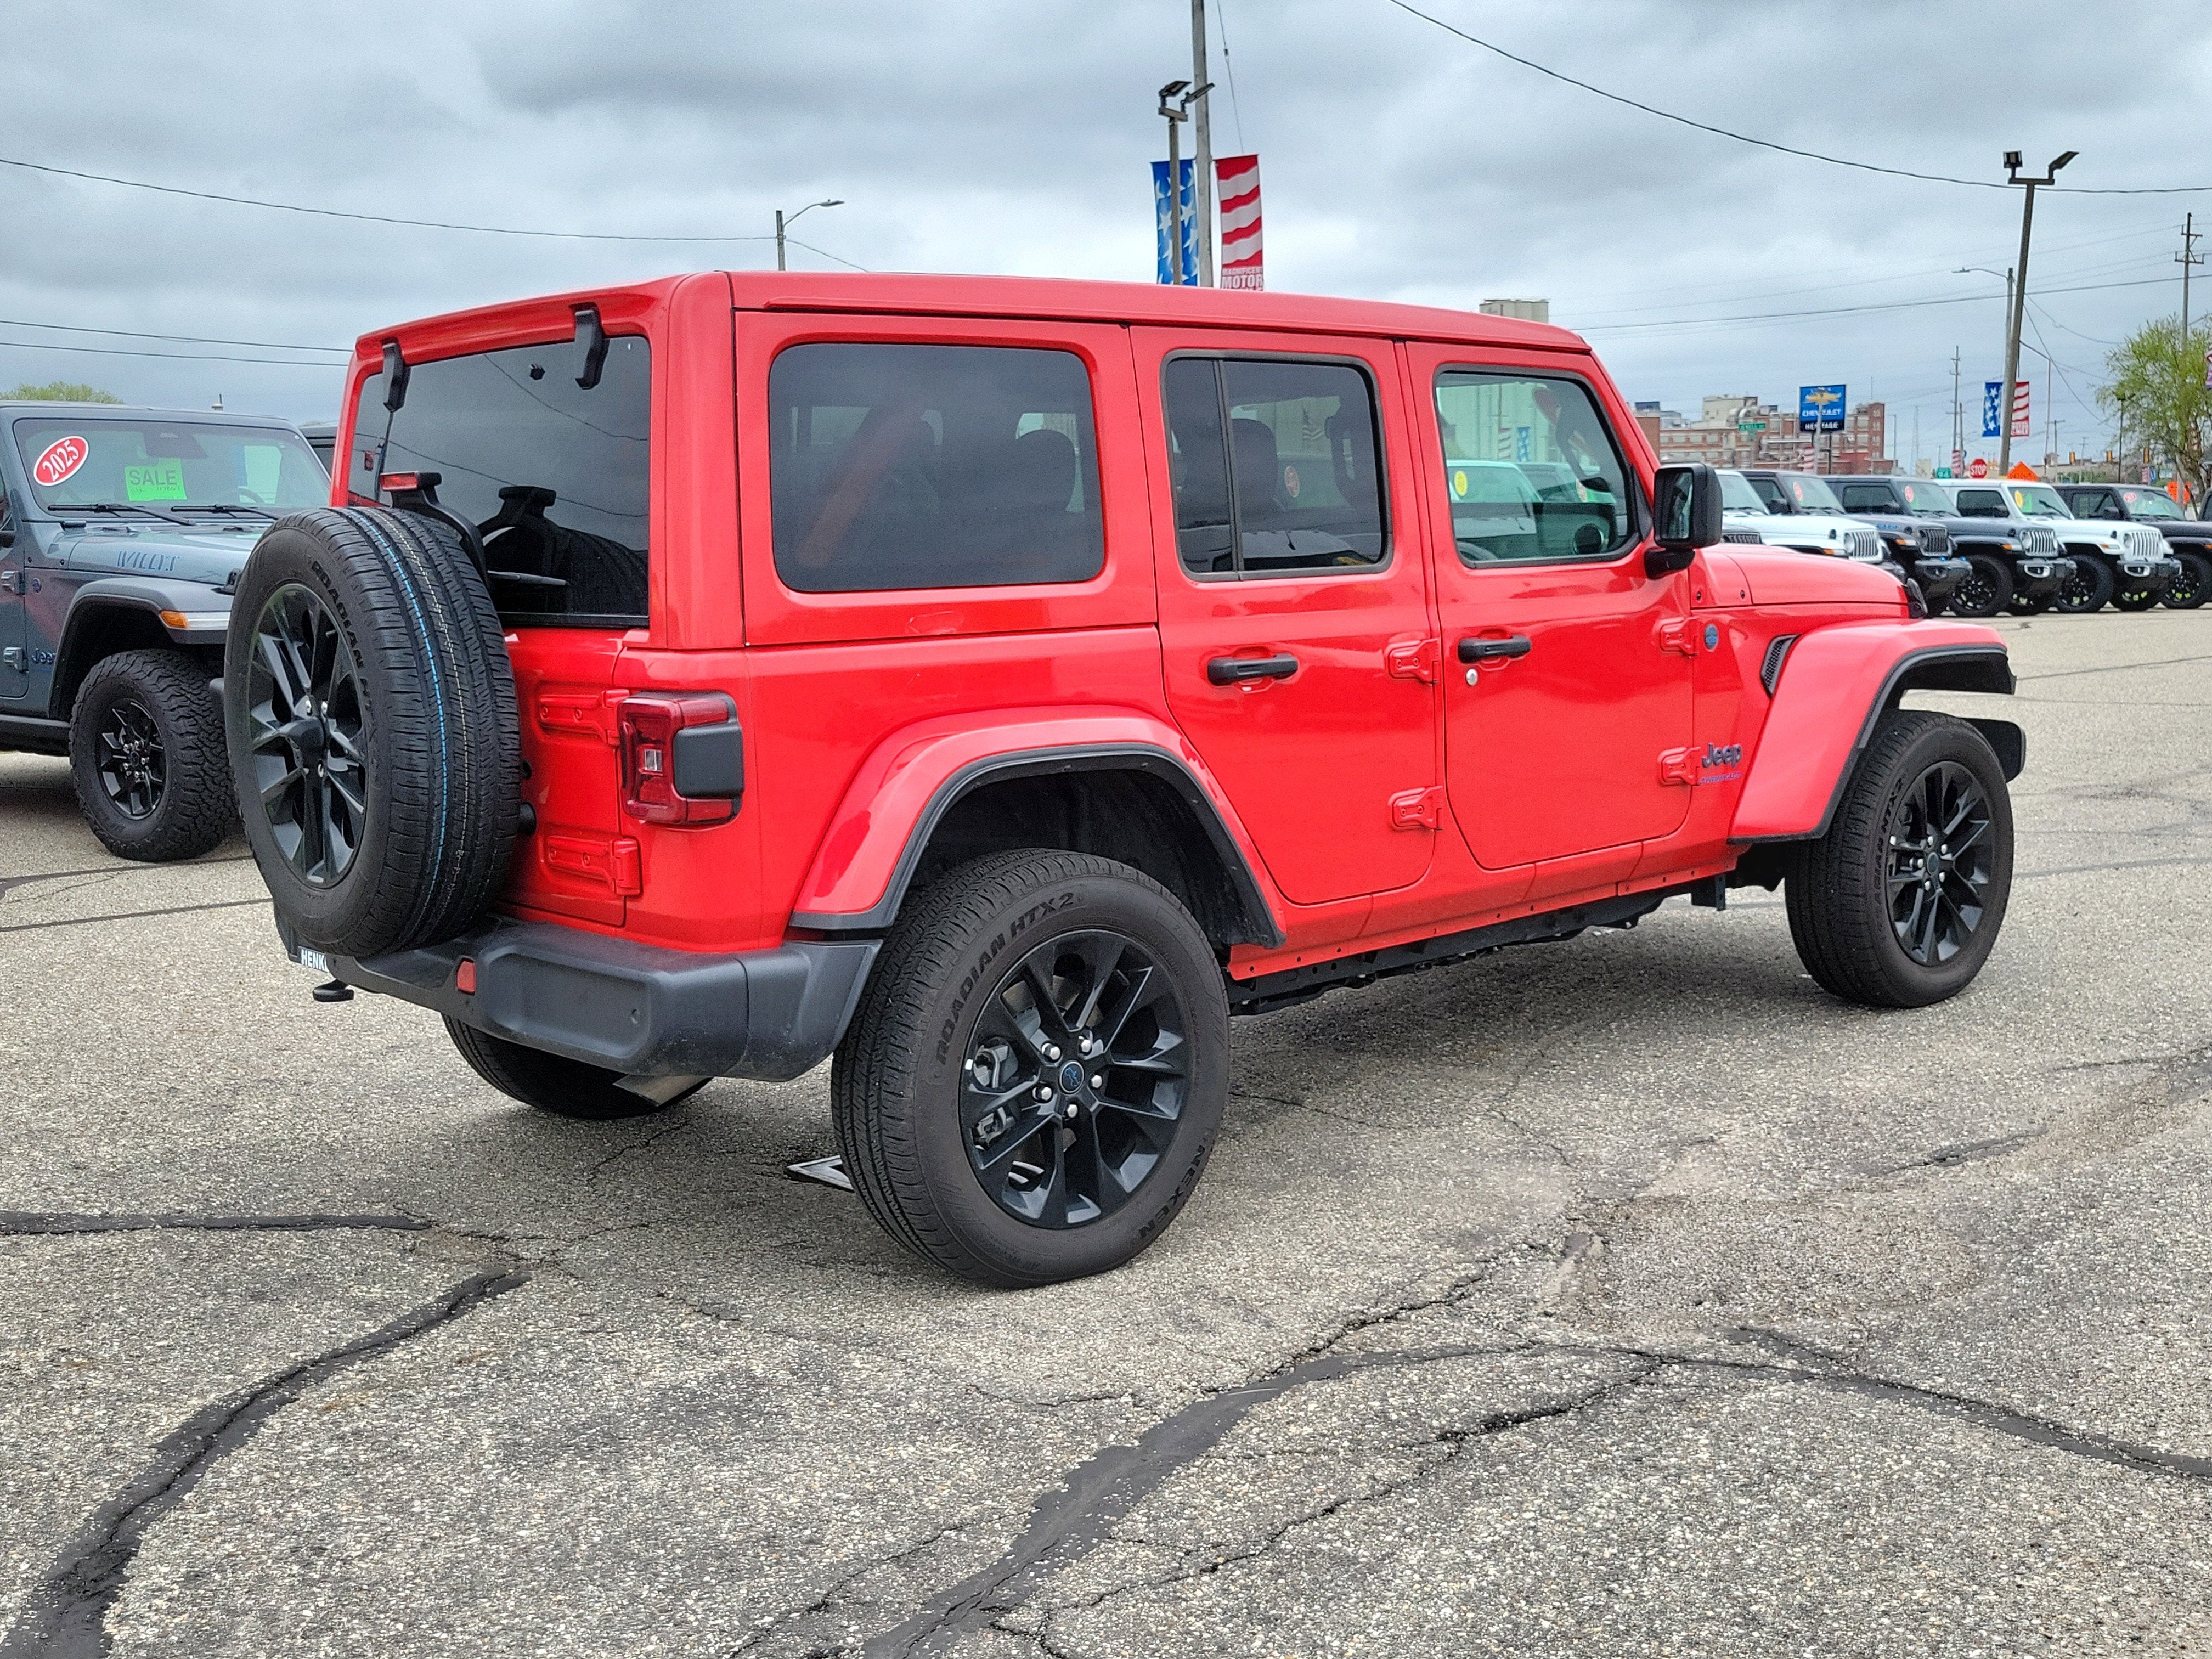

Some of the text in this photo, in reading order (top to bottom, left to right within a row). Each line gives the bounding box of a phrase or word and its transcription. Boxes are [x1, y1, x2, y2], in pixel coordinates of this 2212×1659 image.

[1222, 274, 1263, 289] MOTOR
[1802, 408, 1842, 417] CHEVOLET
[1805, 421, 1838, 430] HERTAGE
[42, 439, 79, 482] 2025
[129, 470, 178, 486] SALE
[1970, 464, 1987, 476] STOP
[1701, 742, 1742, 768] Jeep
[935, 892, 1074, 1065] ROADIAN HTX2
[1139, 1145, 1206, 1239] NEXEN
